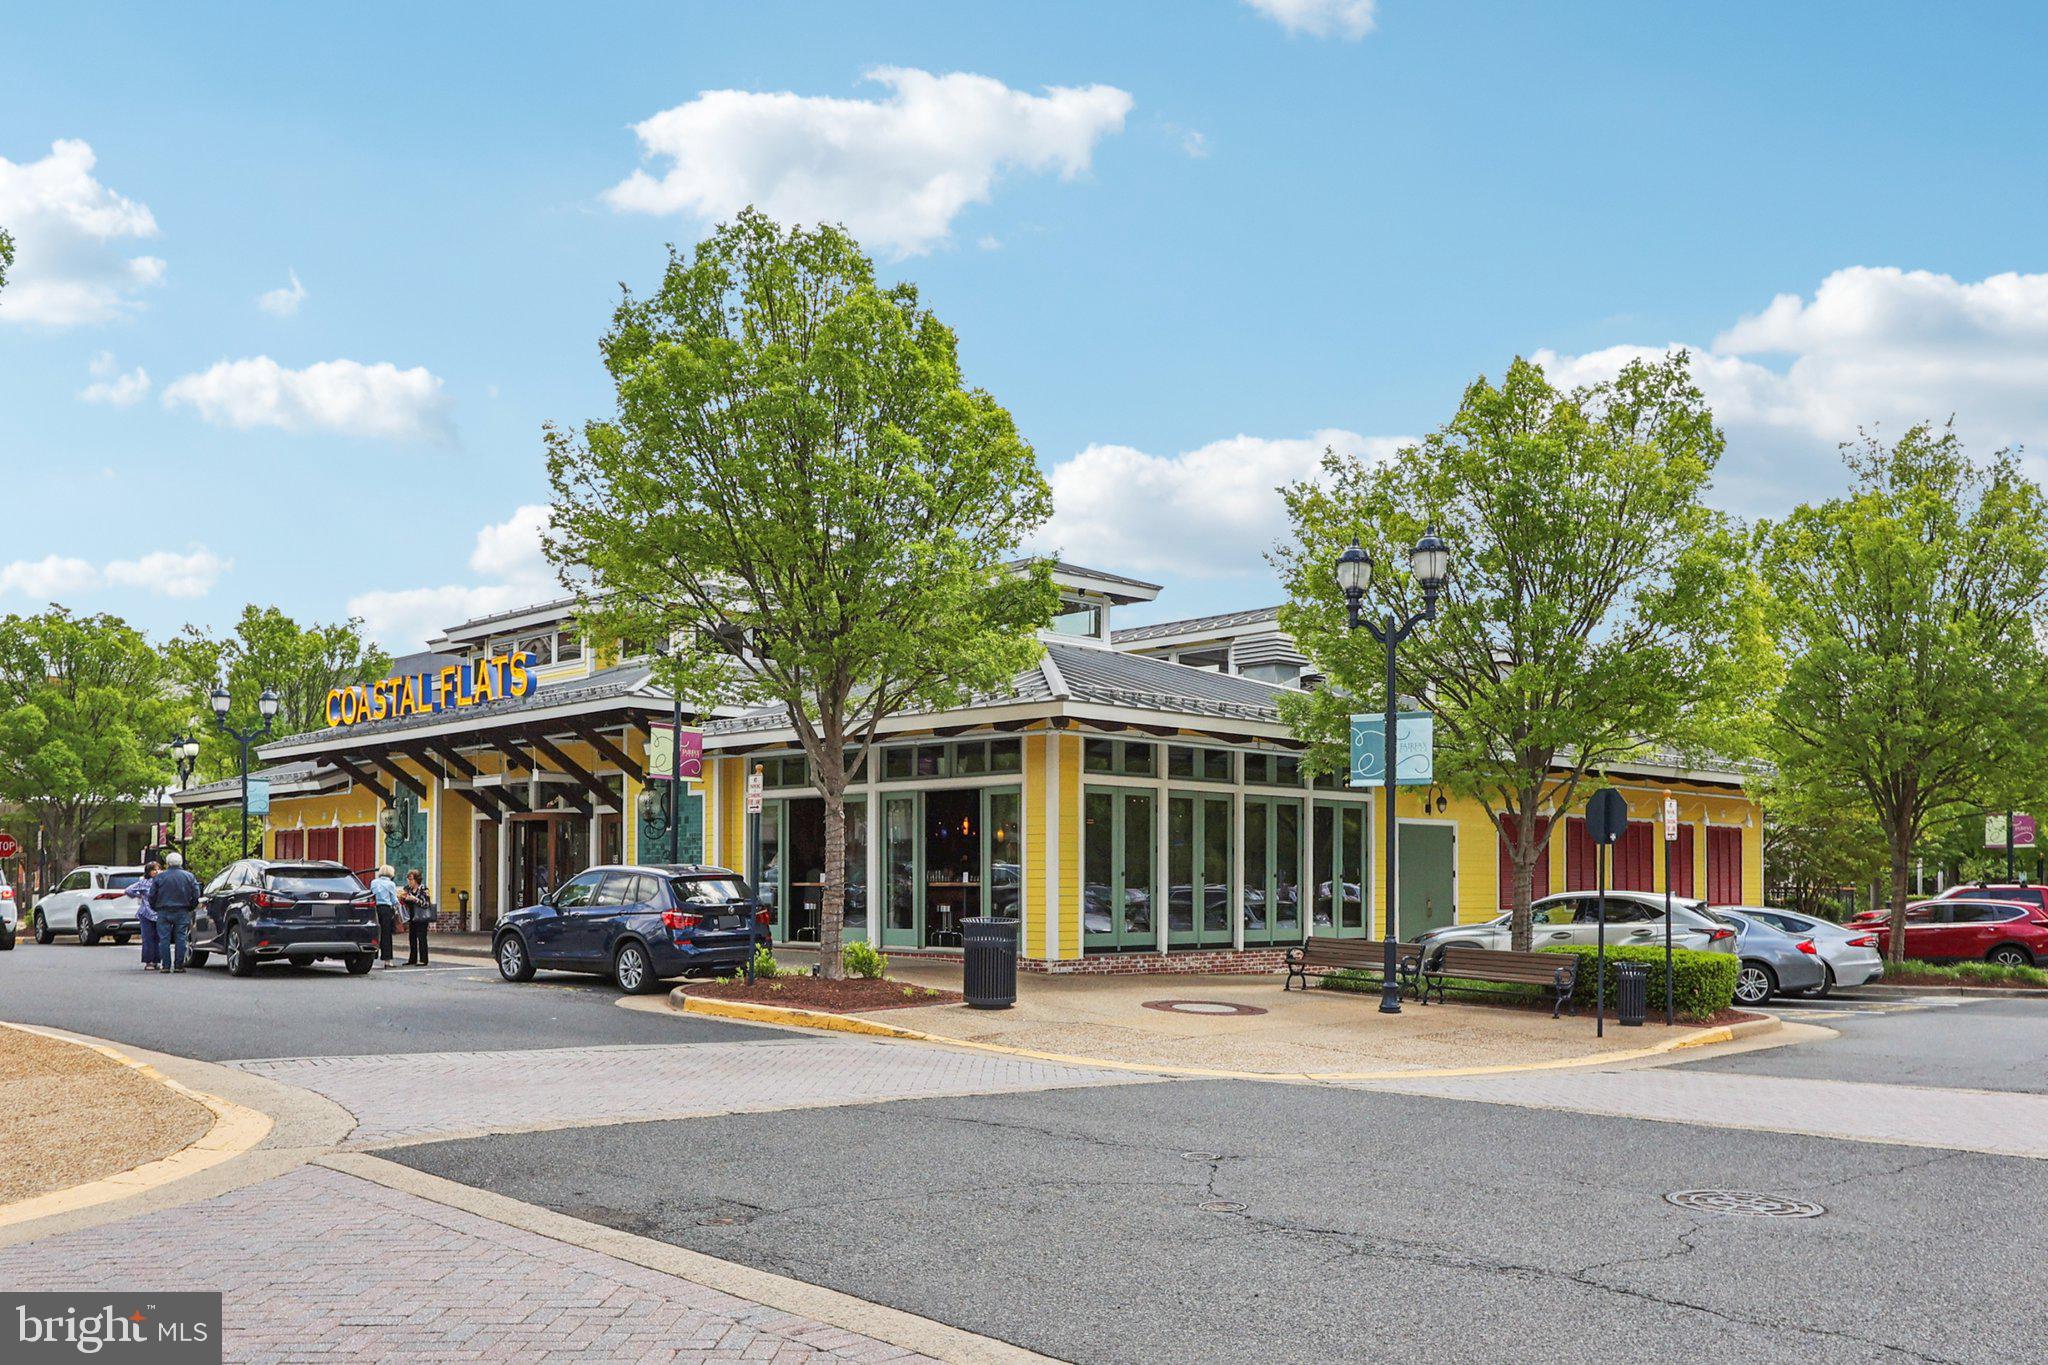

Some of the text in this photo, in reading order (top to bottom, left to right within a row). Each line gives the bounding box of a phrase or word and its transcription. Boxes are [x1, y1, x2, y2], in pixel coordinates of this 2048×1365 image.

[326, 651, 532, 727] COASTAL FLATS
[0, 841, 16, 851] TOP
